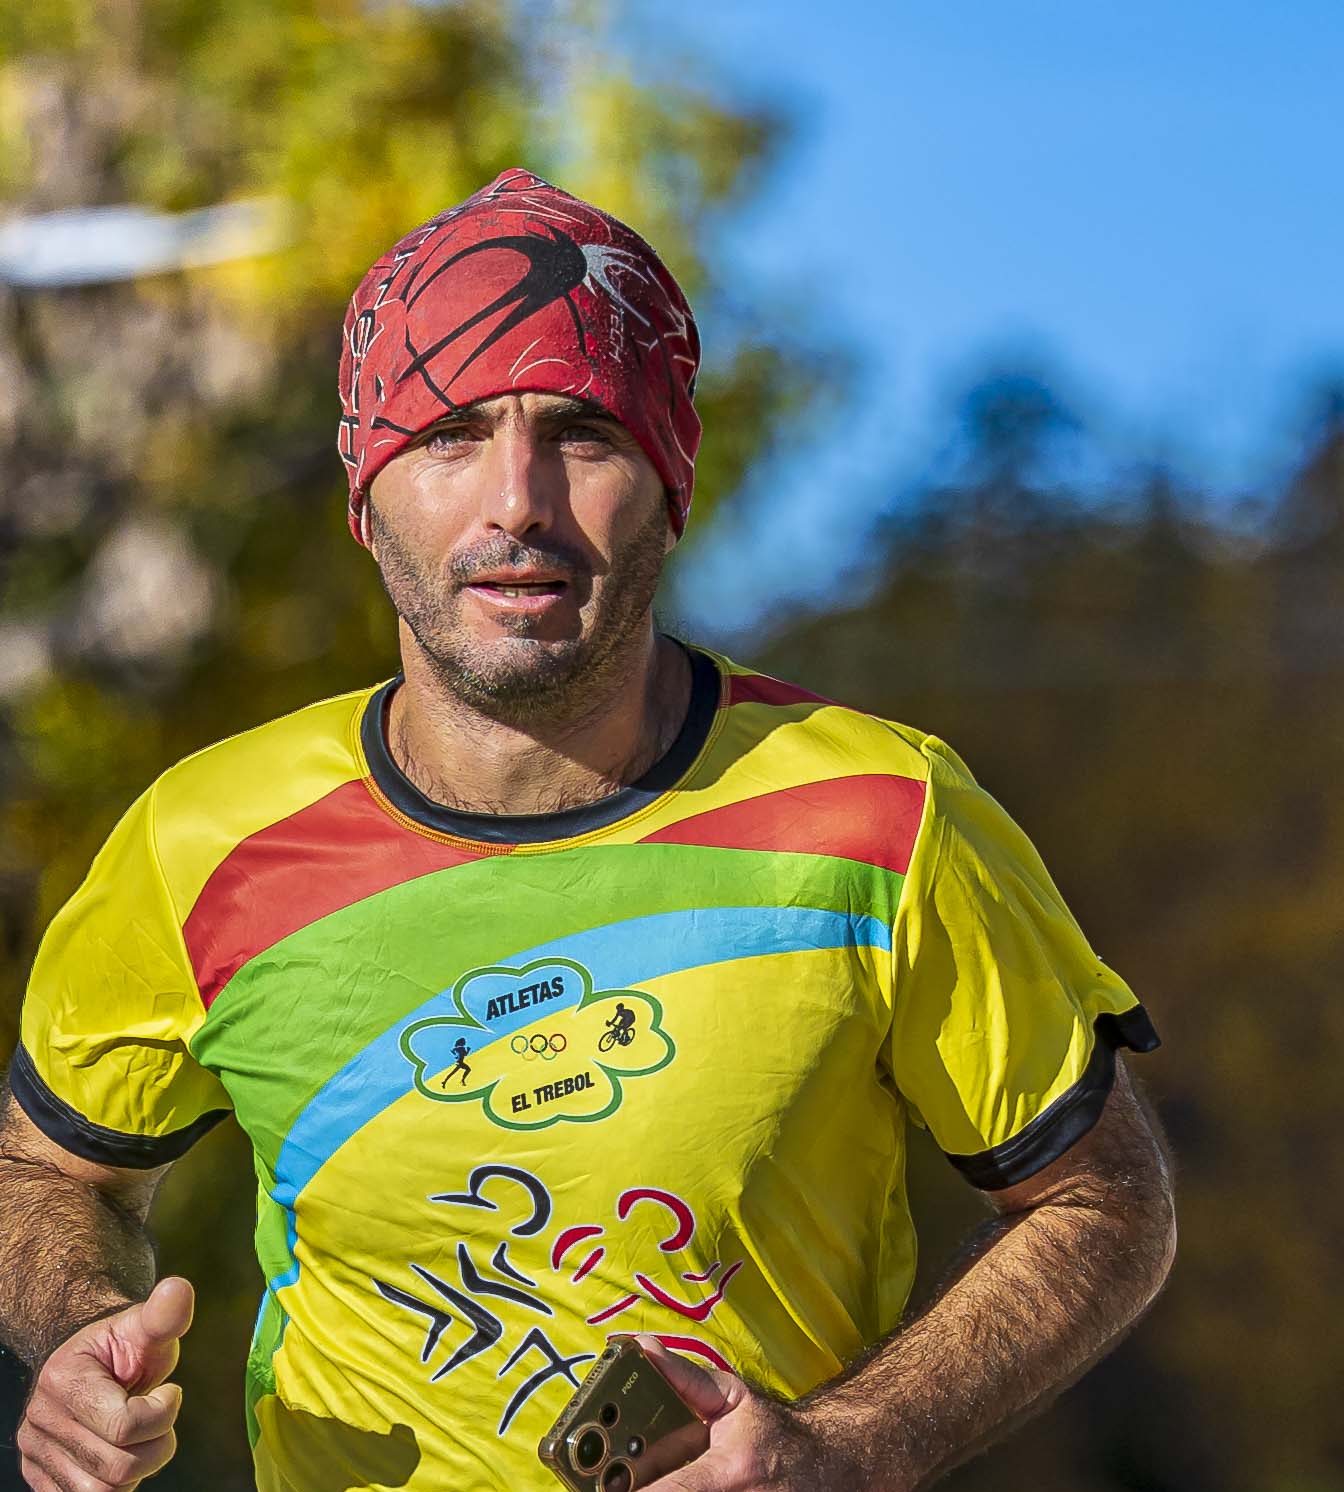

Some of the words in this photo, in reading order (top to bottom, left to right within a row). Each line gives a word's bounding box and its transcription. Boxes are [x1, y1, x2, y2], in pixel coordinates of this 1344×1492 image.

[485, 976, 564, 1021] ATLETAS
[511, 1094, 532, 1113] EL
[533, 1071, 595, 1106] TREBOL
[621, 1371, 639, 1395] POCO
